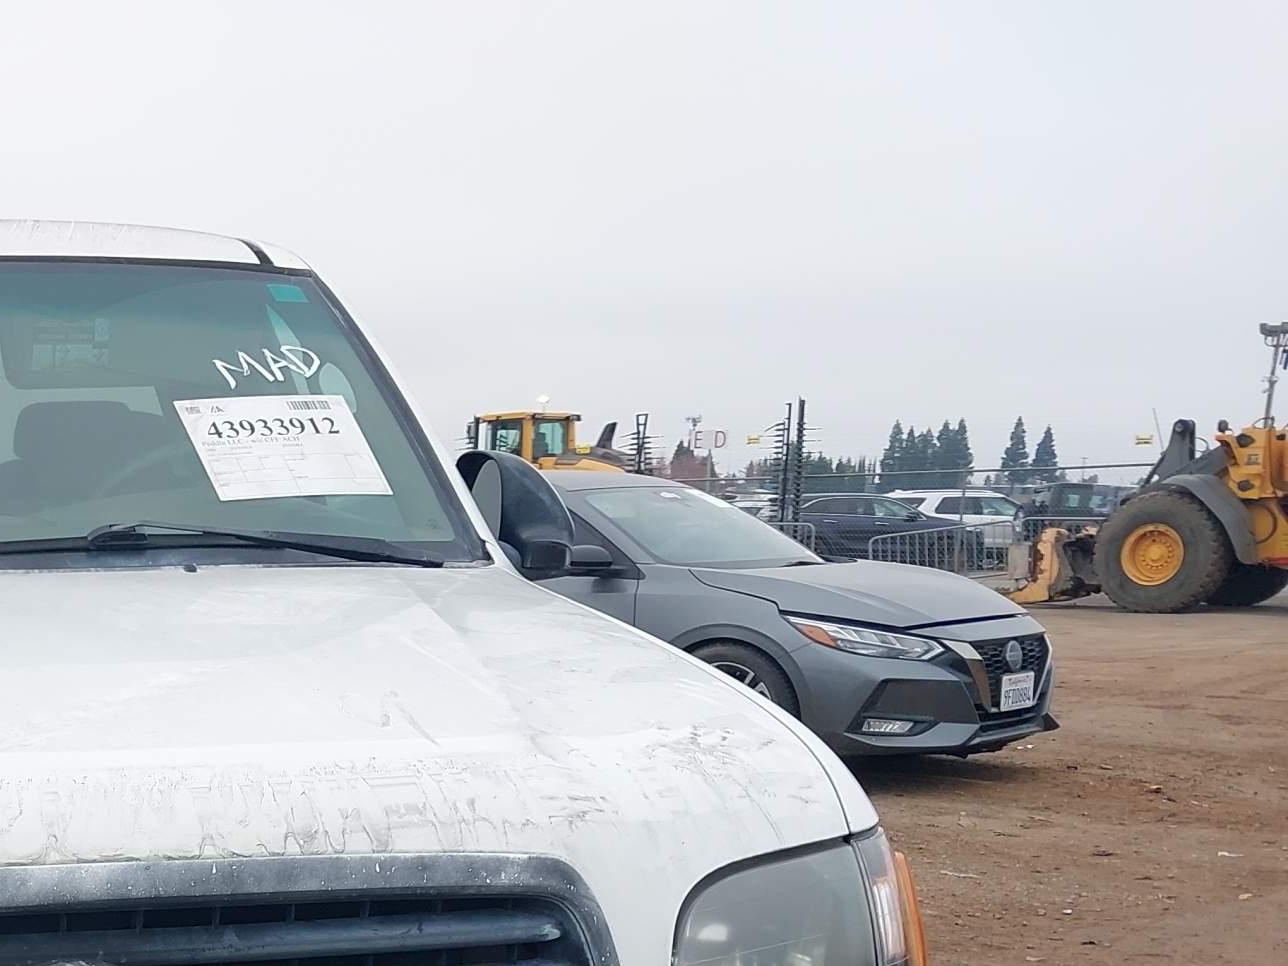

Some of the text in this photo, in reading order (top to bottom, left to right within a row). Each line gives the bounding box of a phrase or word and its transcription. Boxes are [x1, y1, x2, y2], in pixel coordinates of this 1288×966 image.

[212, 345, 321, 390] MAD
[207, 417, 340, 438] 43933912
[714, 430, 727, 449] D
